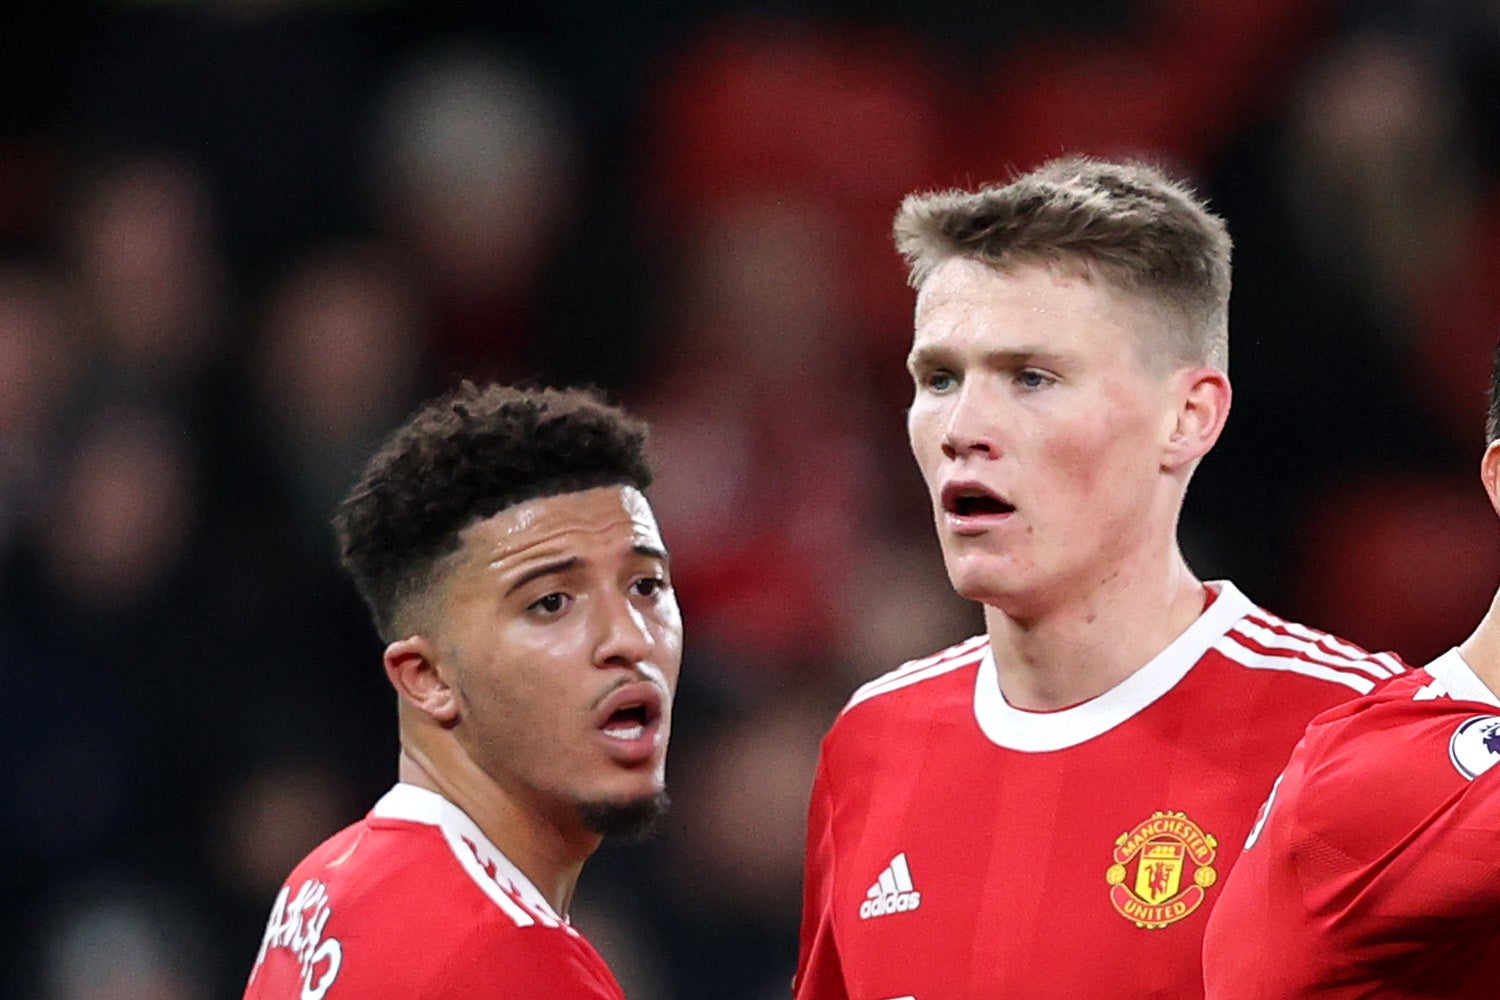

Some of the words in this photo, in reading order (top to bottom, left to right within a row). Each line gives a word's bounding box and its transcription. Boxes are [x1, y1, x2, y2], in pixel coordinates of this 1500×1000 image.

[1121, 820, 1209, 859] MANCHESTER
[859, 891, 921, 920] adidas
[1123, 899, 1187, 921] UNITED
